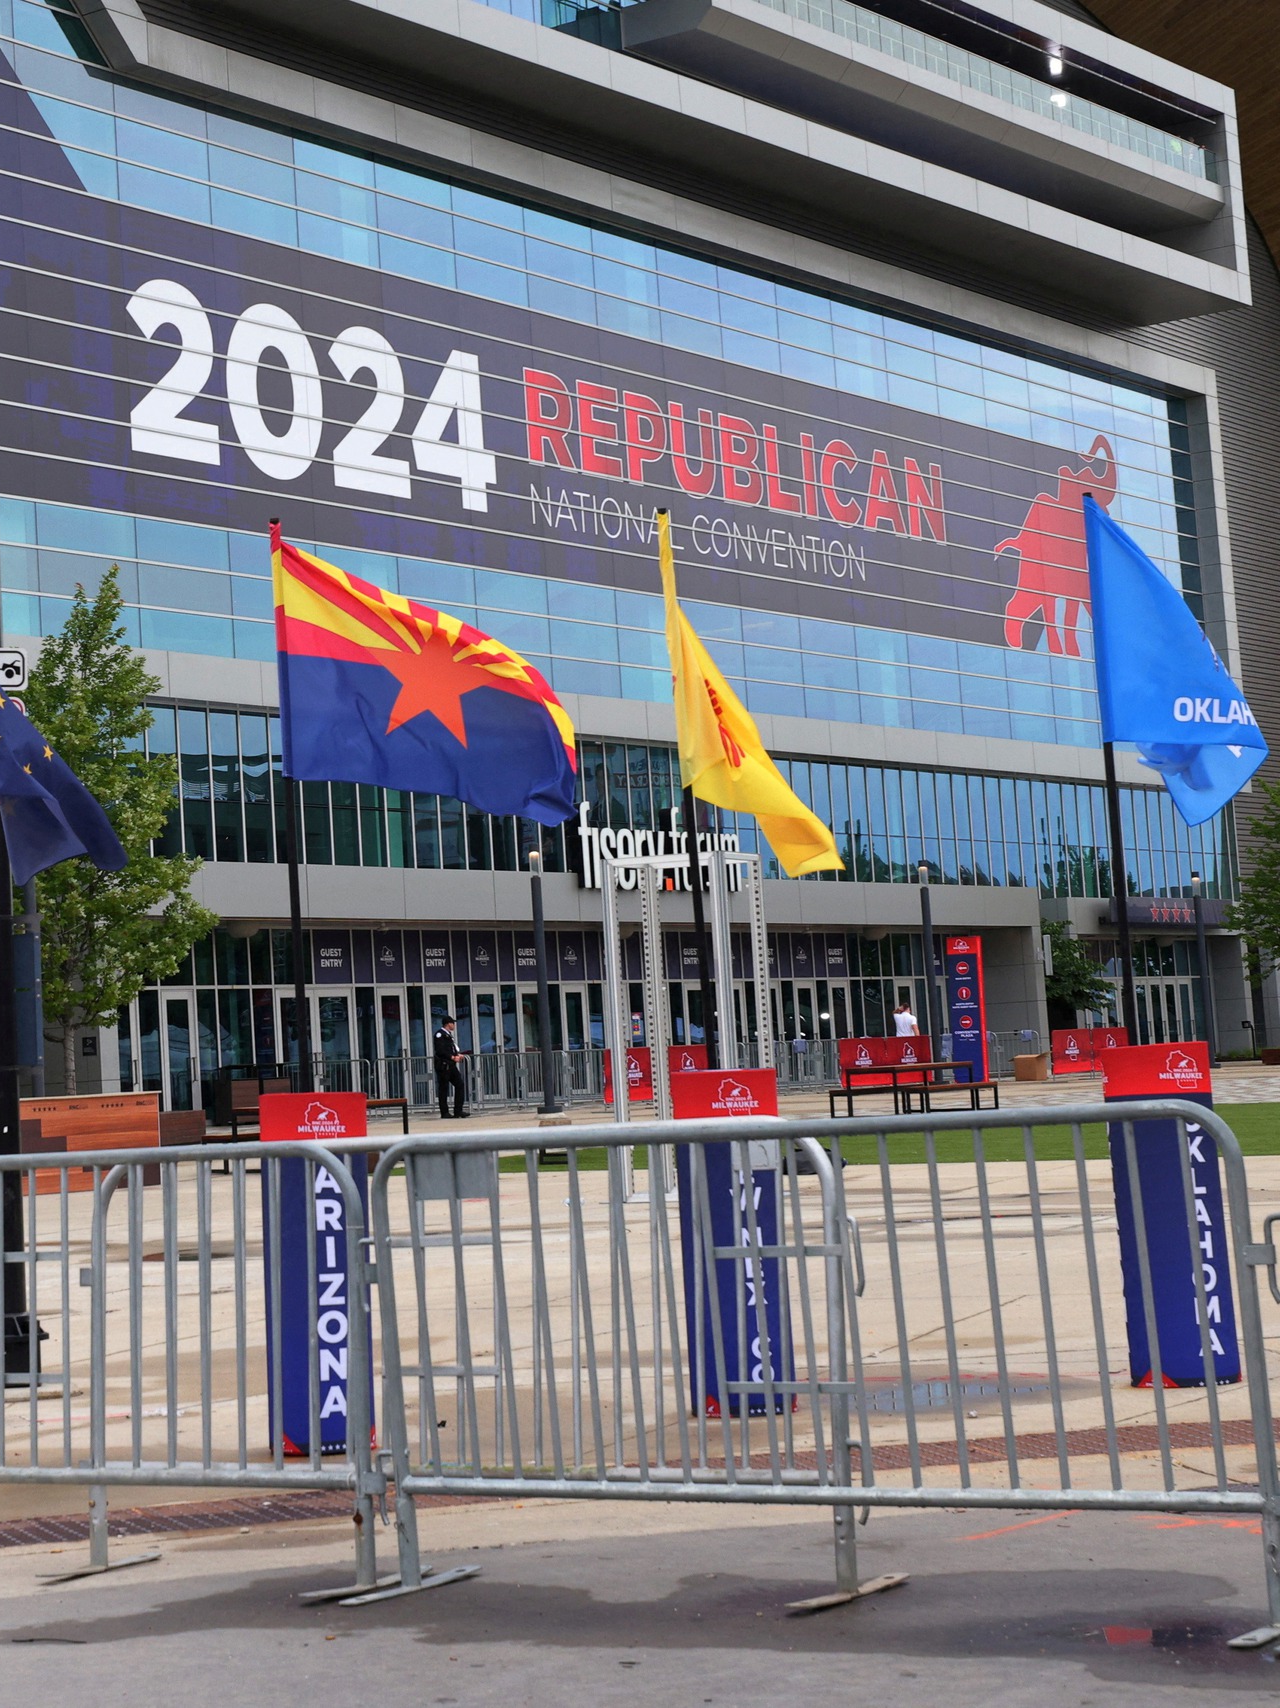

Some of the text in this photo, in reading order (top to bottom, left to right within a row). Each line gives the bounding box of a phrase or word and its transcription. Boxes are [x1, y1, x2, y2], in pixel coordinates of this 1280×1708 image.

[126, 279, 497, 513] 2024
[523, 367, 947, 546] REPUBLICAN
[692, 515, 866, 581] CONVENTION
[1173, 697, 1258, 728] OKLAH
[320, 948, 342, 957] GUEST
[425, 948, 446, 957] GUEST
[828, 948, 843, 956] GUEST
[321, 958, 343, 967] ENTRY
[426, 958, 446, 967] ENTRY
[828, 956, 843, 965] ENTRY
[712, 1100, 759, 1109] MILWAUKEE
[297, 1125, 346, 1133] MILWAUKEE
[314, 1165, 348, 1418] ARIZONA
